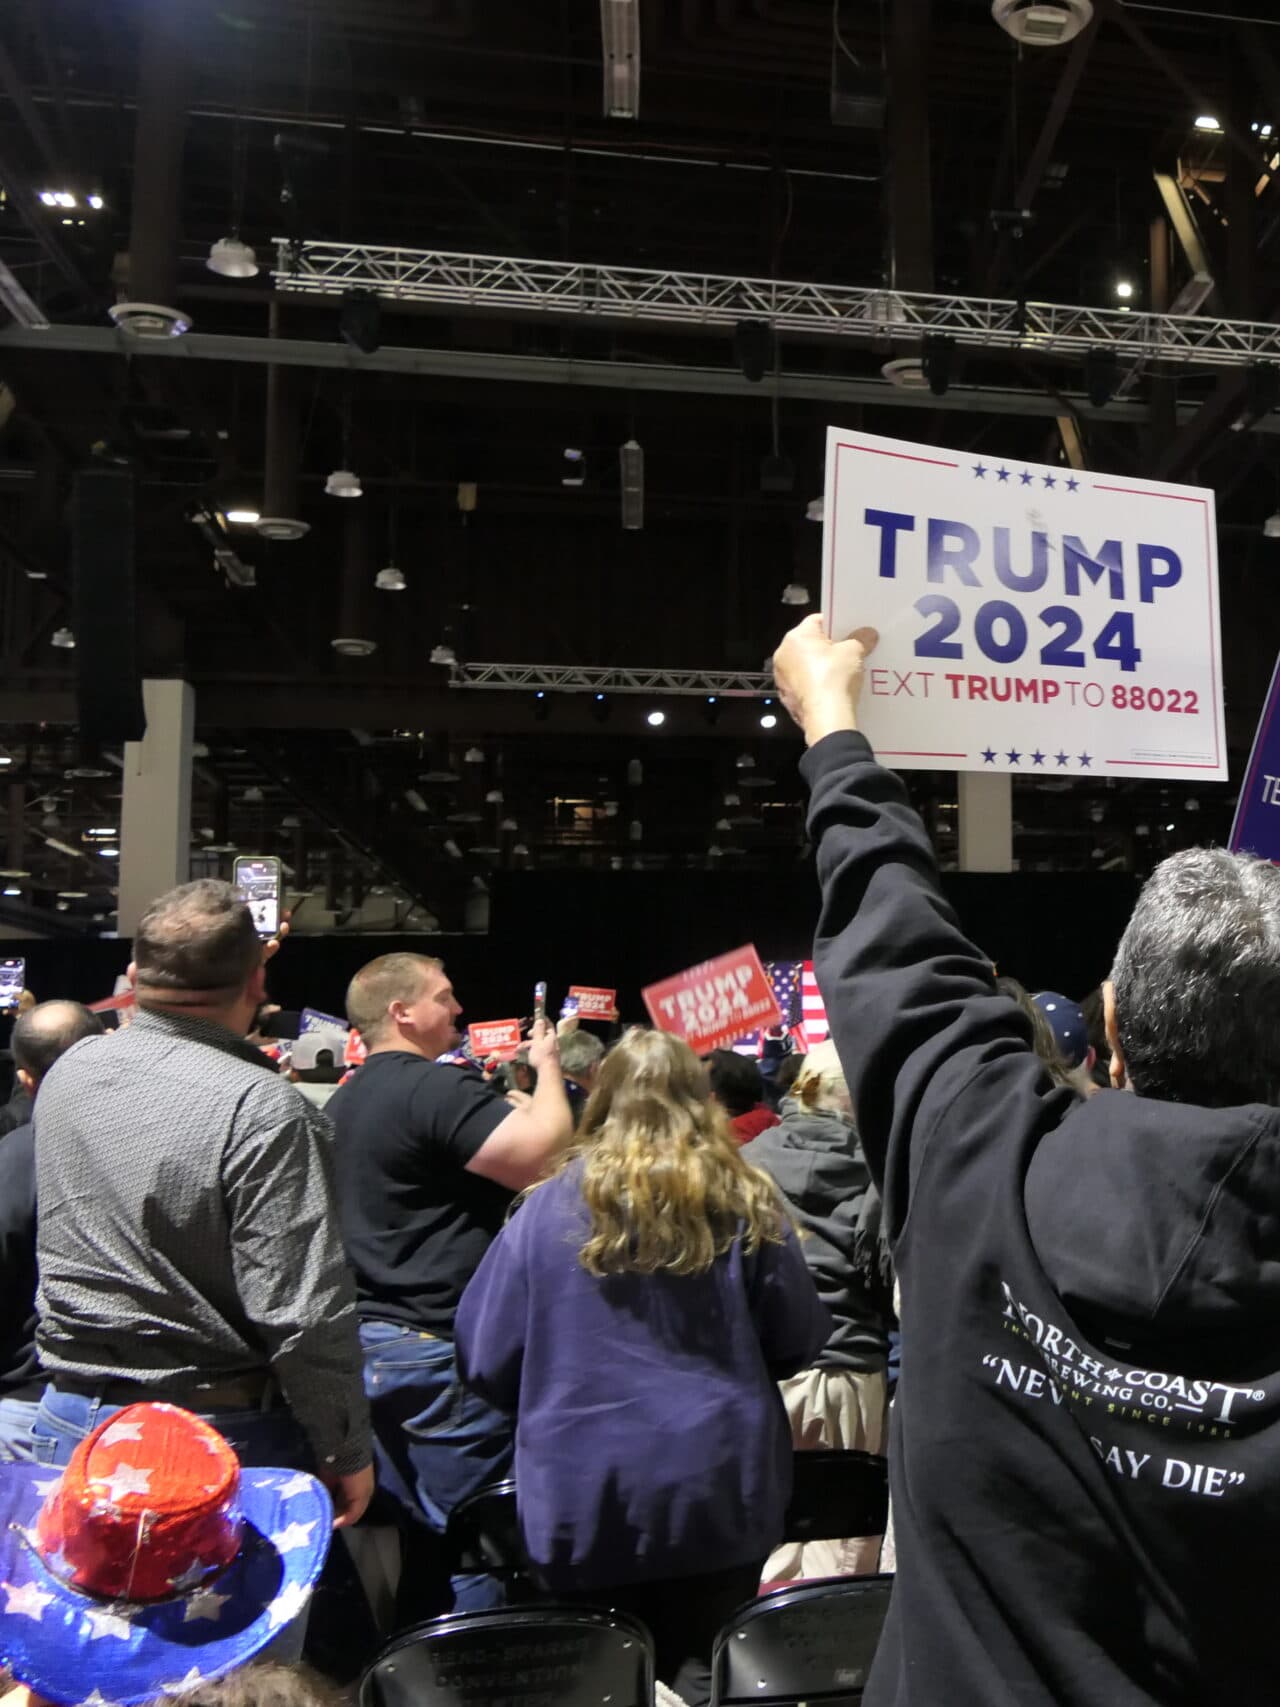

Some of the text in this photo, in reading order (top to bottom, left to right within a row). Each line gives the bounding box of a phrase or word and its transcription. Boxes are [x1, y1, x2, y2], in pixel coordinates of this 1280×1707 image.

[864, 507, 1183, 603] TRUMP
[913, 594, 1143, 672] 2024
[869, 669, 1200, 714] EXT TRUMP TO 88022
[574, 991, 612, 1003] TRUMP
[659, 965, 753, 1019] TRUMP
[685, 988, 749, 1034] 2024
[474, 1025, 515, 1039] TRUMP
[1107, 1403, 1171, 1426] SINCE
[1140, 1392, 1174, 1412] CO.
